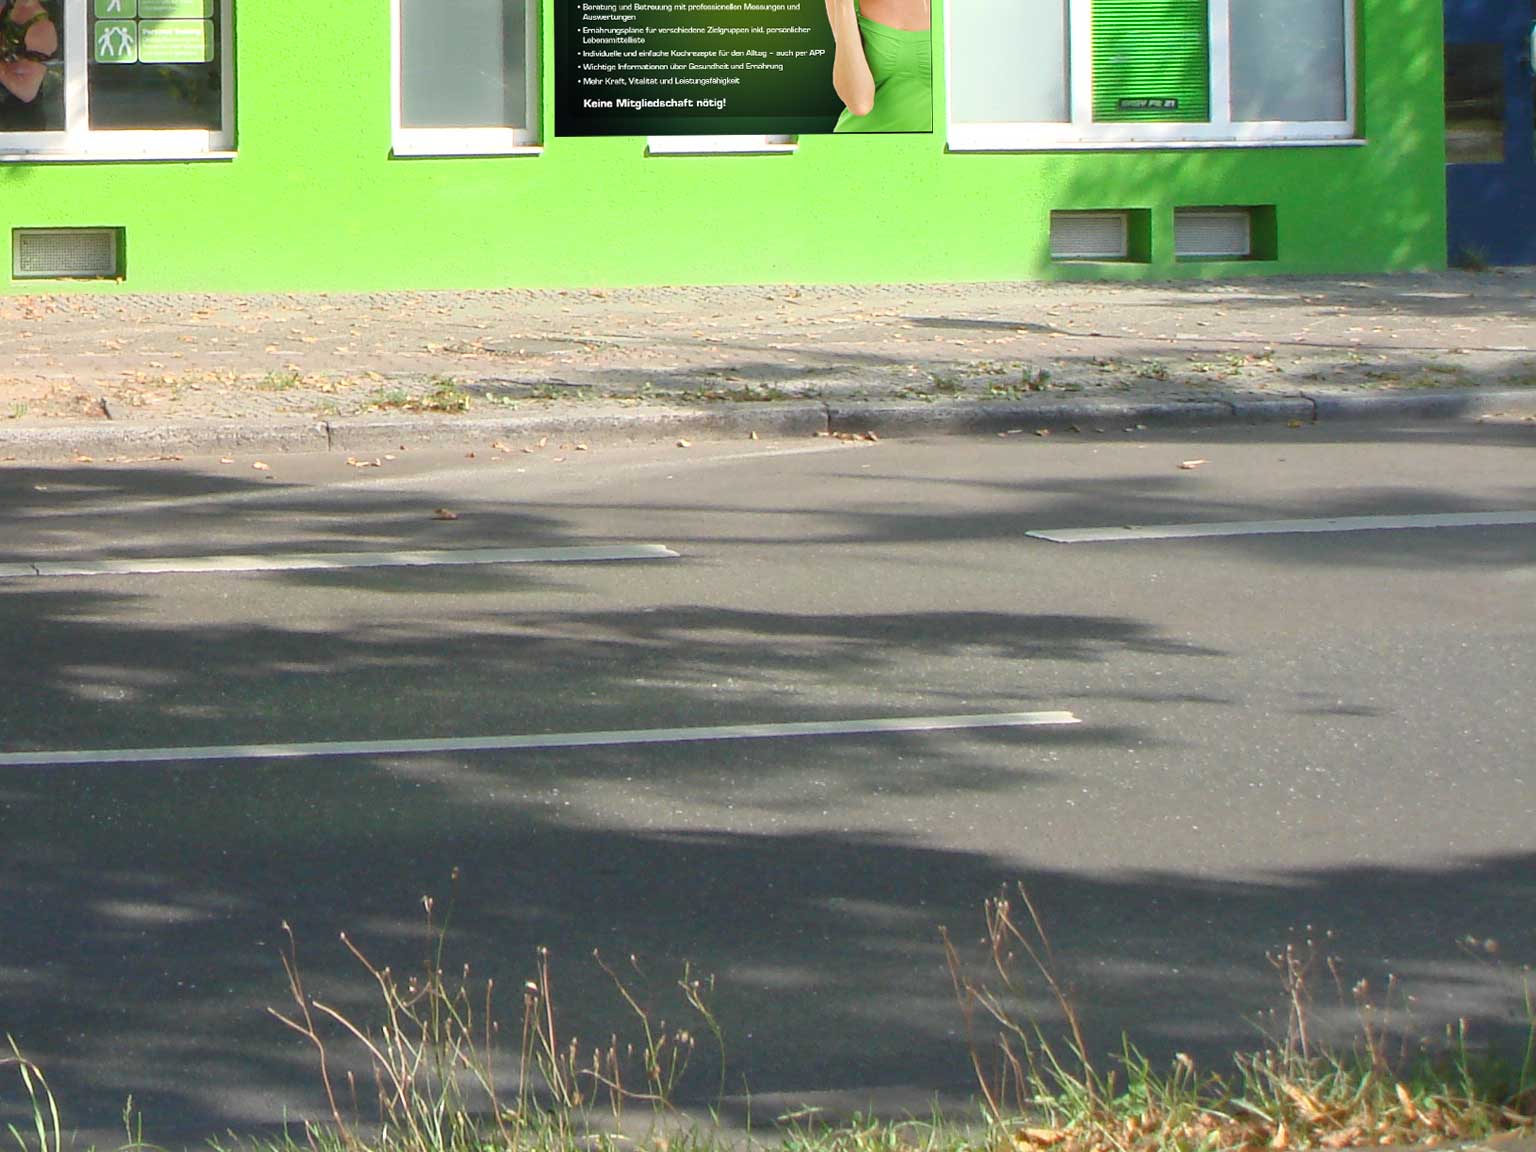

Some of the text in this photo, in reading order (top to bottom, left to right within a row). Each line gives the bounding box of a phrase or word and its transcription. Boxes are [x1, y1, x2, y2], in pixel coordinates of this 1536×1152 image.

[618, 3, 632, 11] und
[674, 3, 686, 11] mit
[786, 3, 801, 11] und
[745, 50, 767, 58] Alltag
[795, 51, 808, 59] per
[809, 49, 825, 57] APP
[582, 63, 616, 72] Wichtige
[659, 77, 673, 85] und
[583, 98, 726, 110] Keine Mitgliedschaft nötig!
